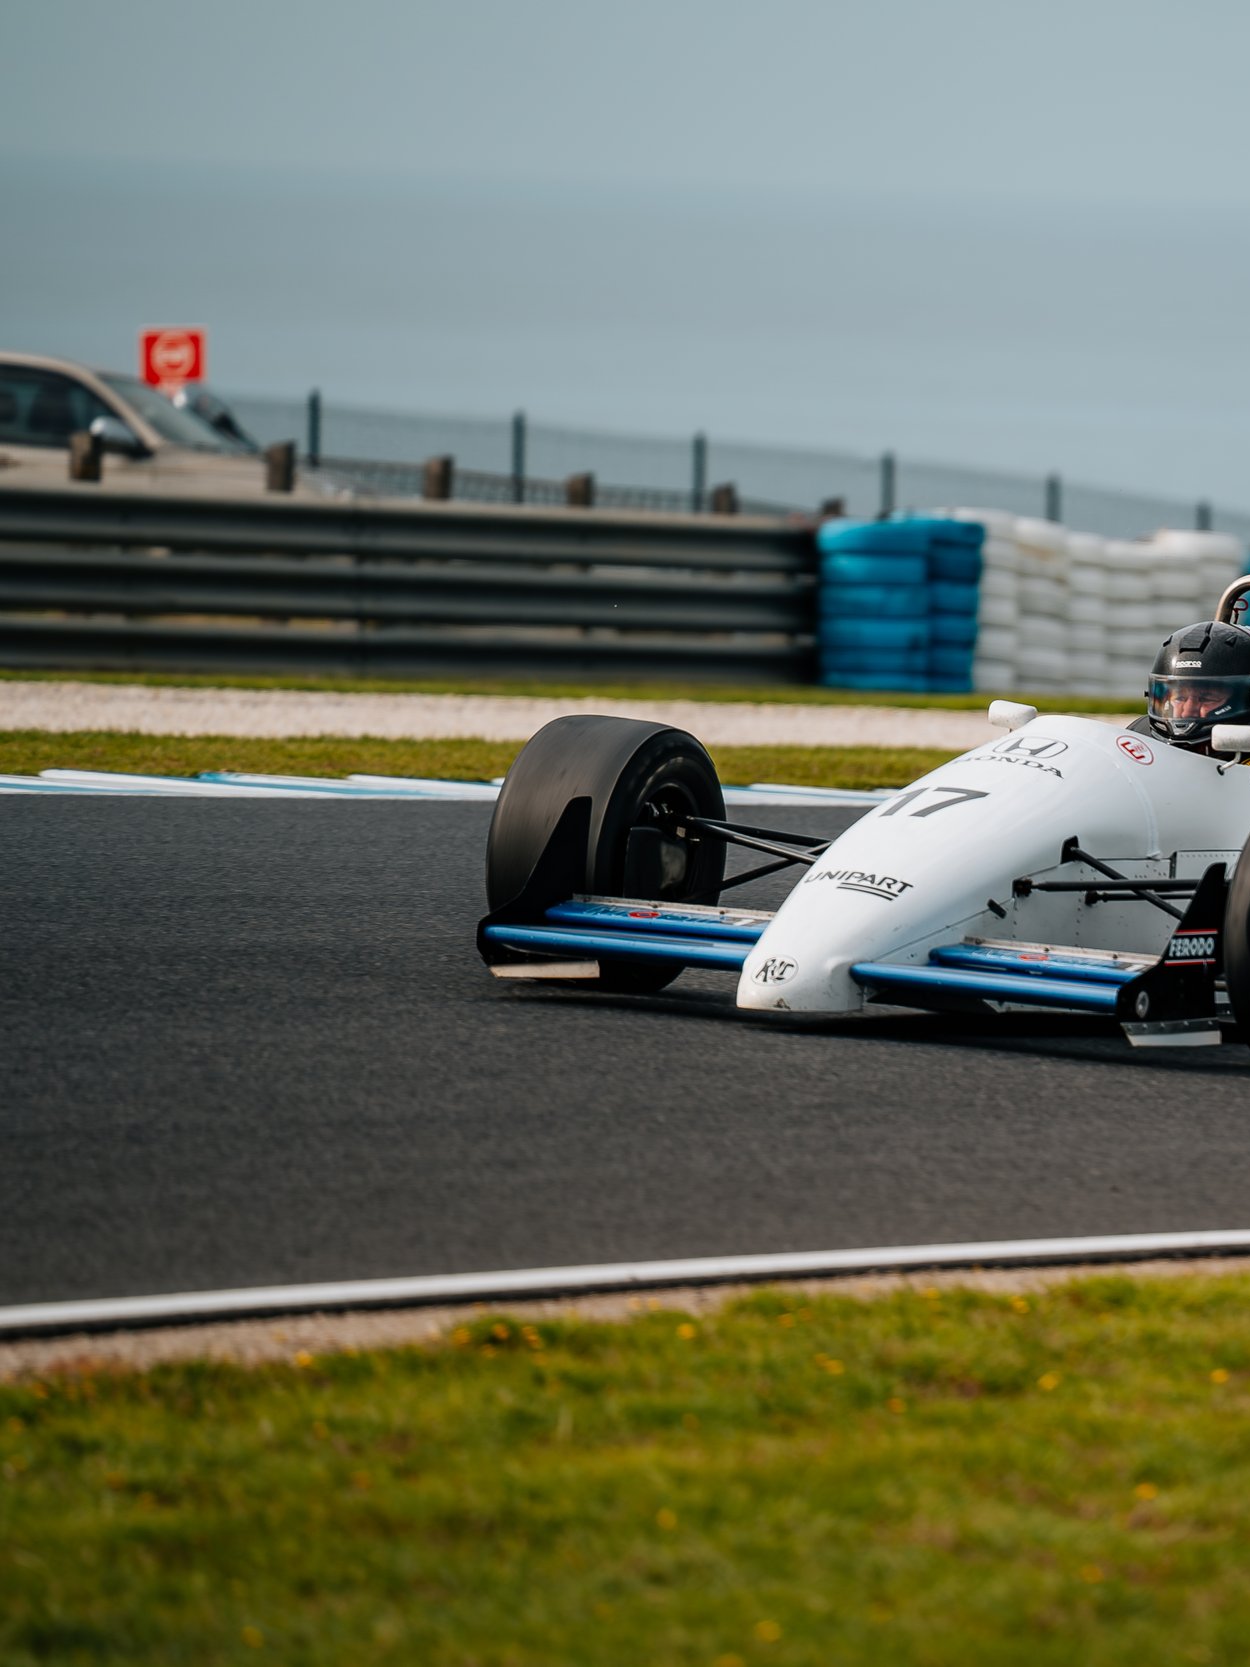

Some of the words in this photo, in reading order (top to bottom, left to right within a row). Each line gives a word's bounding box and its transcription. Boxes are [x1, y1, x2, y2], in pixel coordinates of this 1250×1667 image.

[880, 787, 990, 817] 17
[804, 870, 914, 893] UNIPART
[1169, 937, 1215, 957] FERODO
